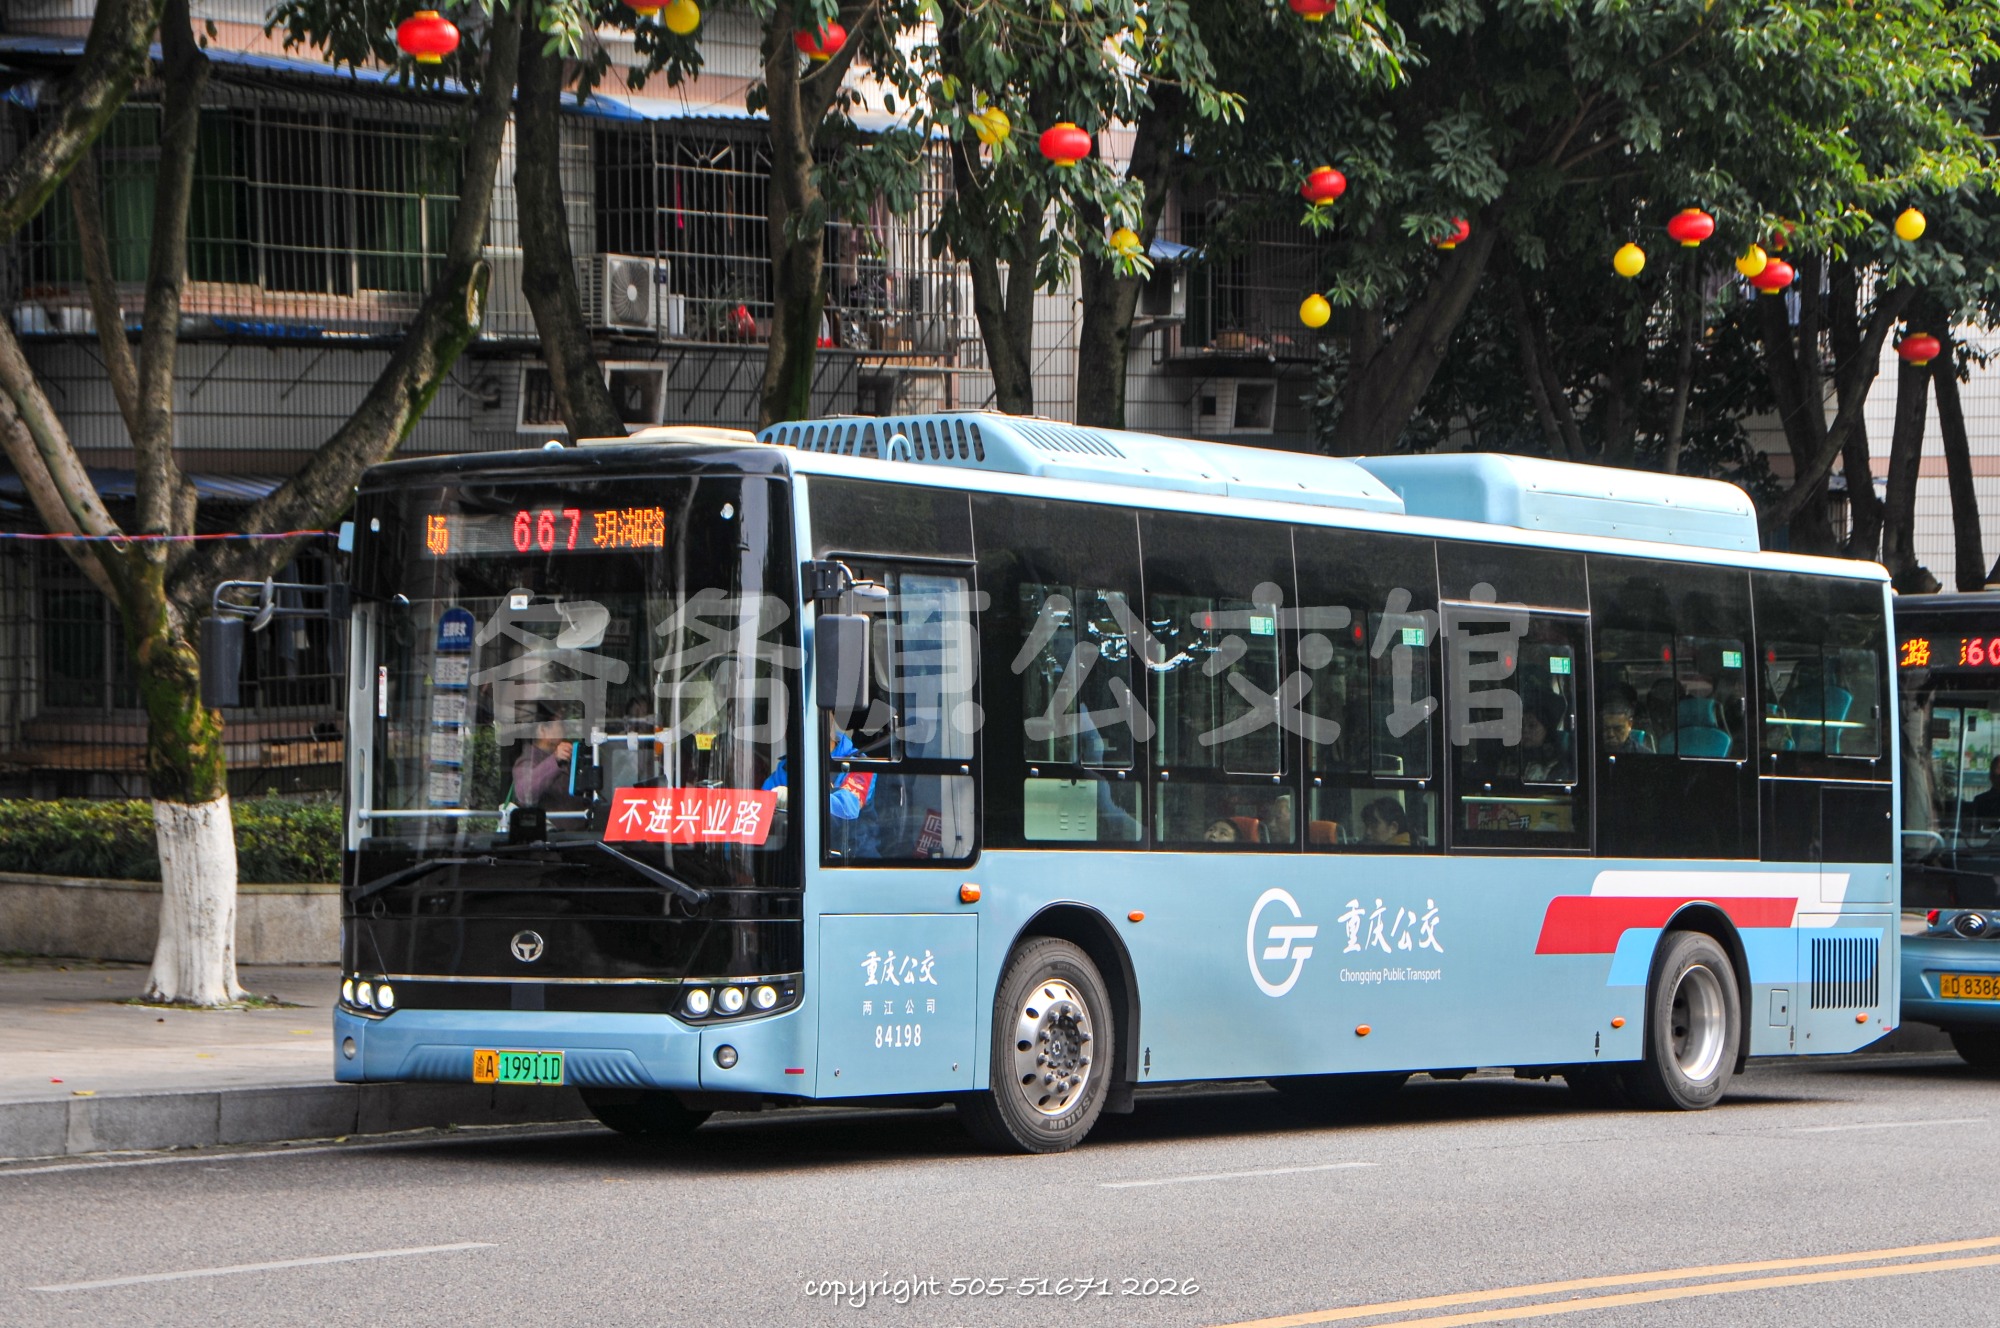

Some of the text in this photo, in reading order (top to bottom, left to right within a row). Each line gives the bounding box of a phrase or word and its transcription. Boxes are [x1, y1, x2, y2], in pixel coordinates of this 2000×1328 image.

[513, 509, 580, 552] 667
[593, 507, 665, 549] 玥湖路
[1901, 638, 1931, 666] 路
[618, 798, 763, 836] 不进兴业路
[1337, 898, 1444, 954] 重庆公交
[860, 949, 938, 986] 重庆公交
[1340, 968, 1441, 984] Chongqing Public Transport
[862, 998, 936, 1016] 两江公司
[875, 1024, 922, 1049] 84198
